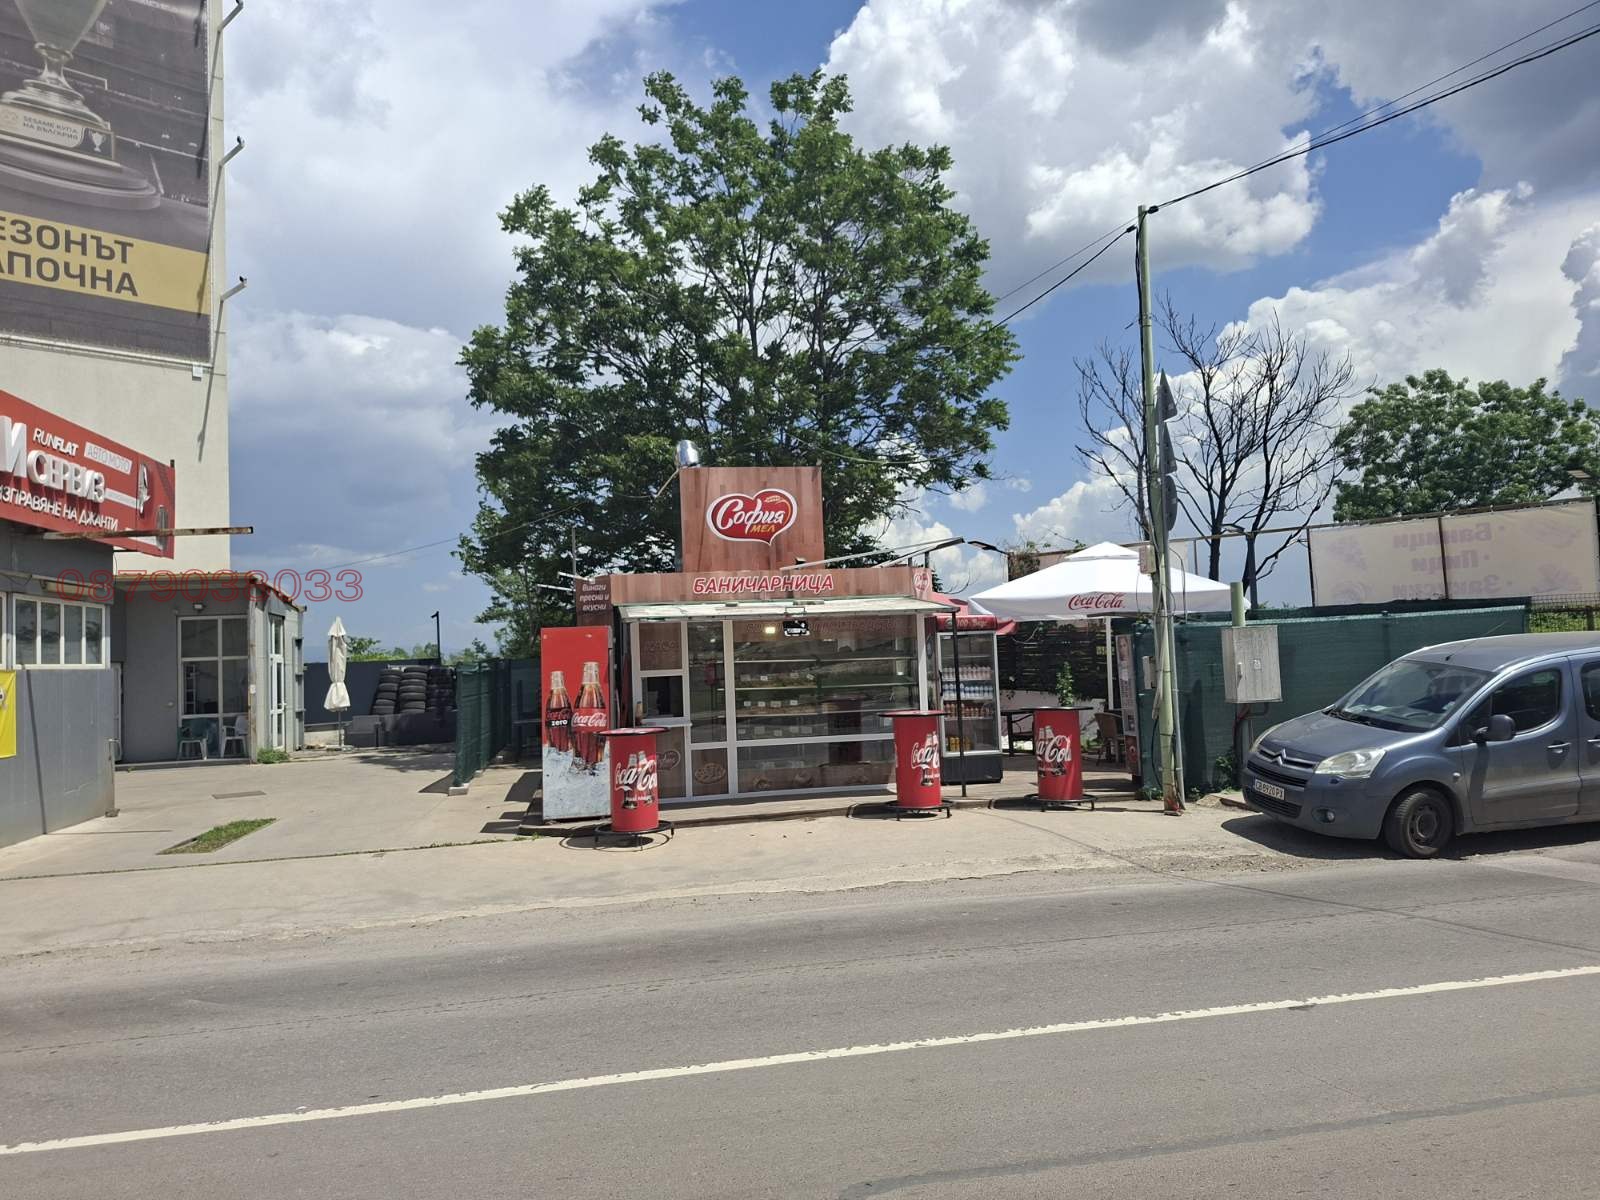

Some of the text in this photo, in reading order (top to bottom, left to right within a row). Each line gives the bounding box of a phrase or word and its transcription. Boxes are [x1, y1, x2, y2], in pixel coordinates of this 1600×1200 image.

[0, 215, 134, 264] ЗОНЪТ
[0, 250, 138, 297] ПОЧНА
[33, 428, 79, 457] RUNFLAT
[27, 450, 105, 503] СЕРВИЗ
[62, 503, 78, 521] НА
[79, 509, 118, 531] ДЖАНТИ
[716, 498, 786, 535] София
[751, 524, 776, 533] МЕЛ
[693, 574, 834, 595] БАНИЧАРНИЦА
[551, 719, 568, 727] zero
